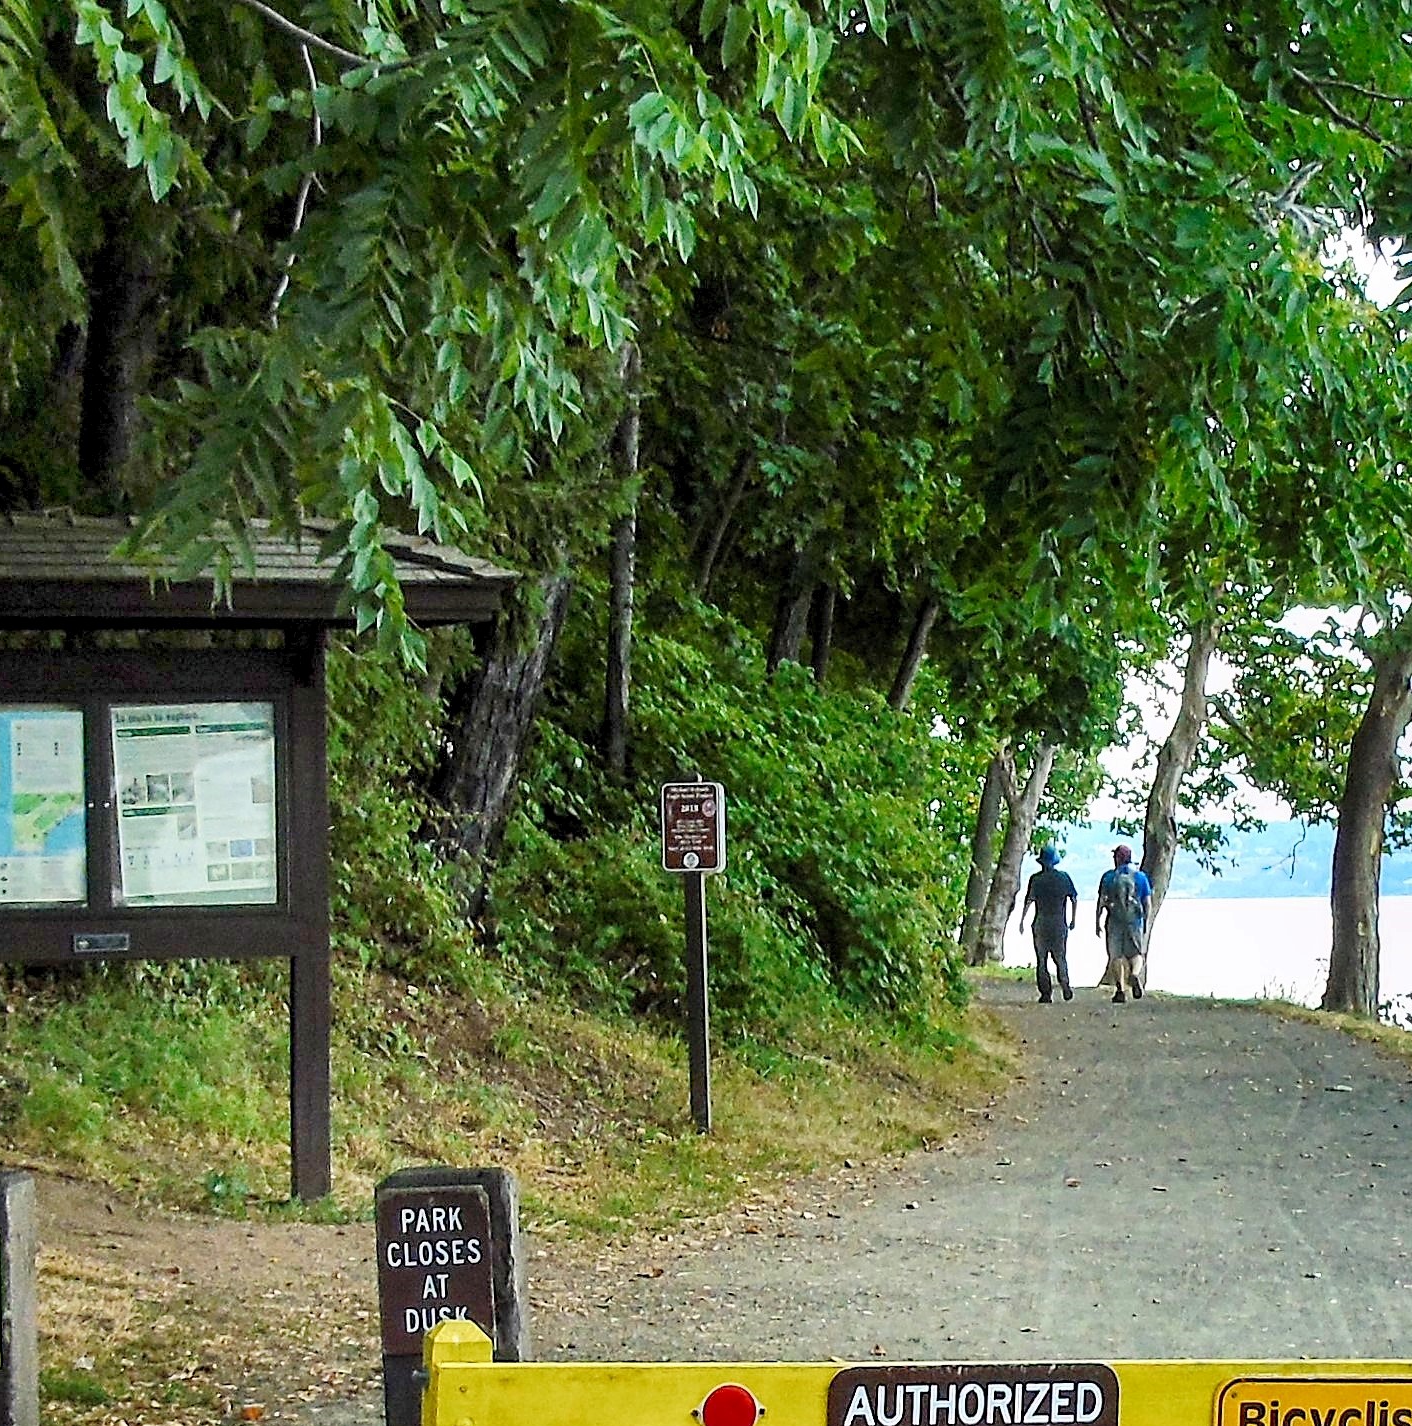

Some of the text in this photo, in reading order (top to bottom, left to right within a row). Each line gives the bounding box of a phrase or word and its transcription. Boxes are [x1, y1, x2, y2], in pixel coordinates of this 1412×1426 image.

[401, 1207, 463, 1233] PARK
[387, 1239, 481, 1267] CLOSES
[423, 1274, 449, 1299] AT
[844, 1383, 1103, 1426] AUTHORIZED
